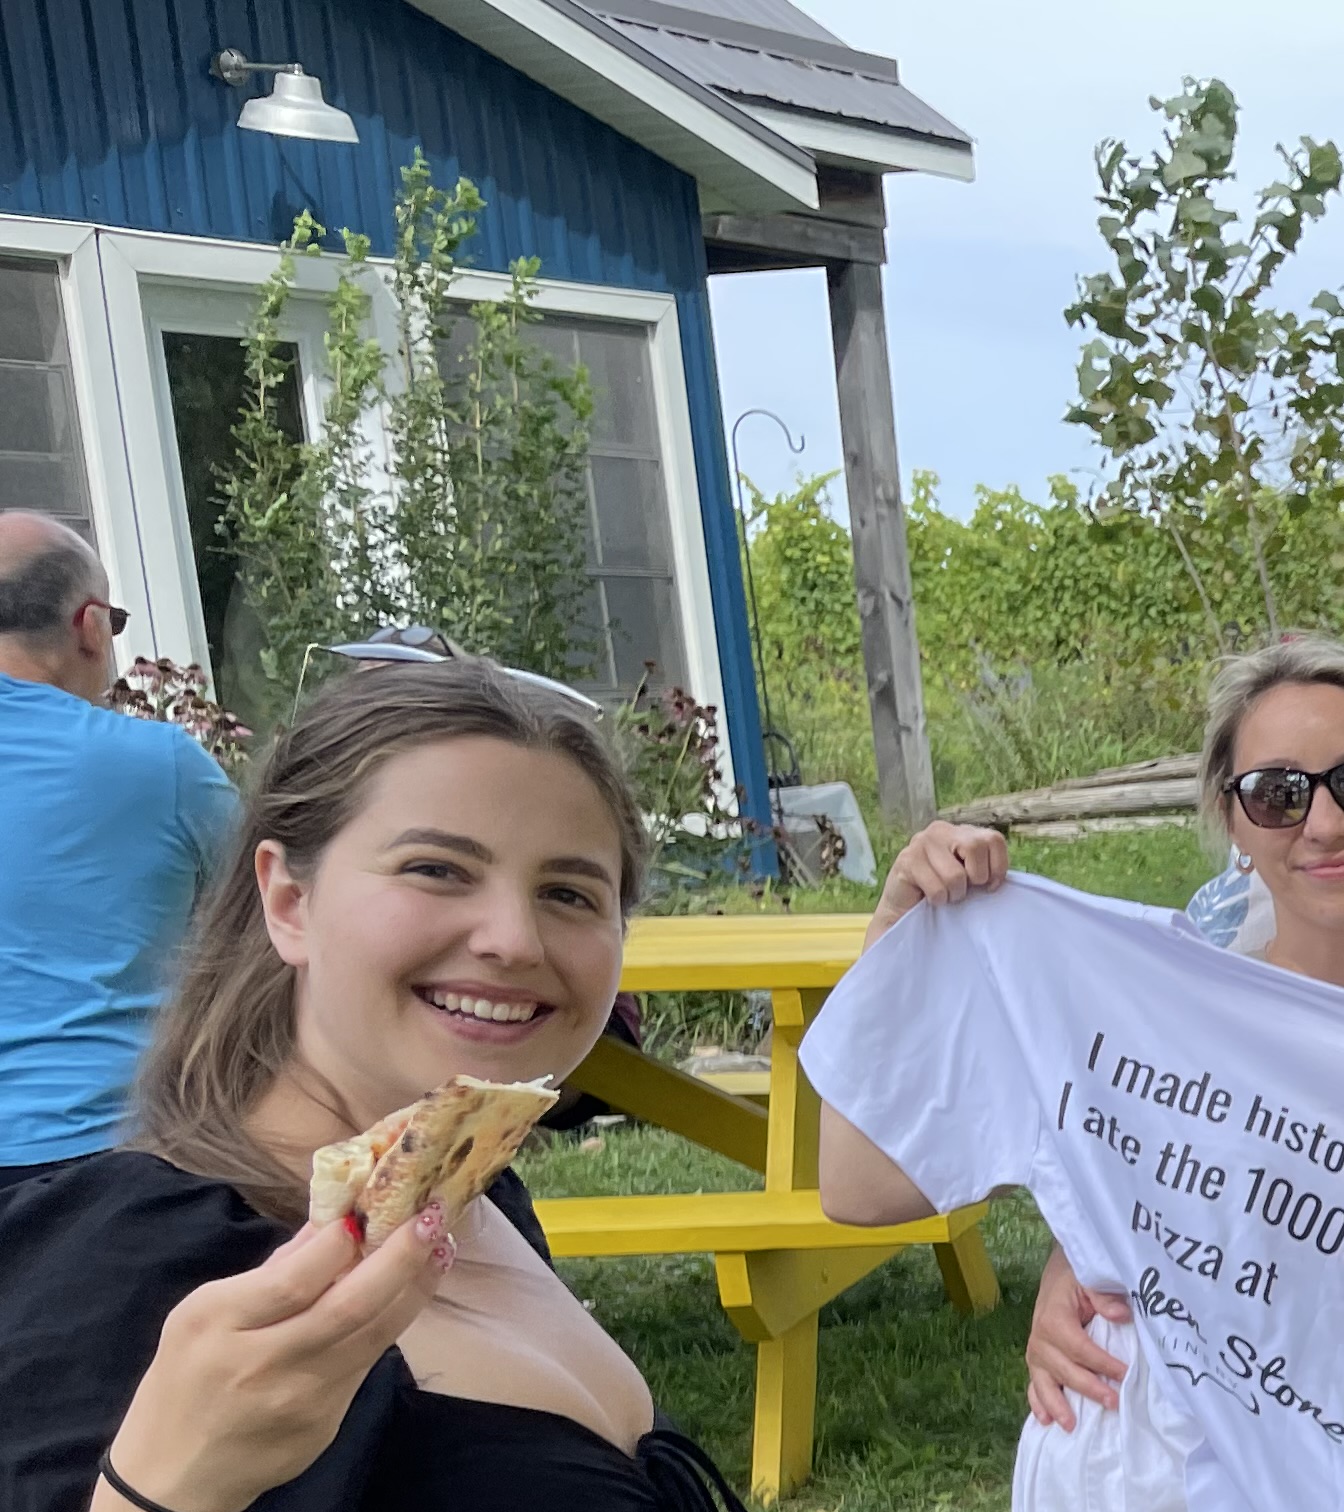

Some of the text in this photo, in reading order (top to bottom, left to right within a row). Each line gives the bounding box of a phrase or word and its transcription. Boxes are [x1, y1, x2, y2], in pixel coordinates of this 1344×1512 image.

[1088, 1032, 1104, 1072] I
[1111, 1055, 1233, 1123] made
[1057, 1081, 1073, 1131] I
[1082, 1105, 1142, 1166] ate
[1155, 1141, 1227, 1202] the
[1131, 1199, 1279, 1306] pizza at
